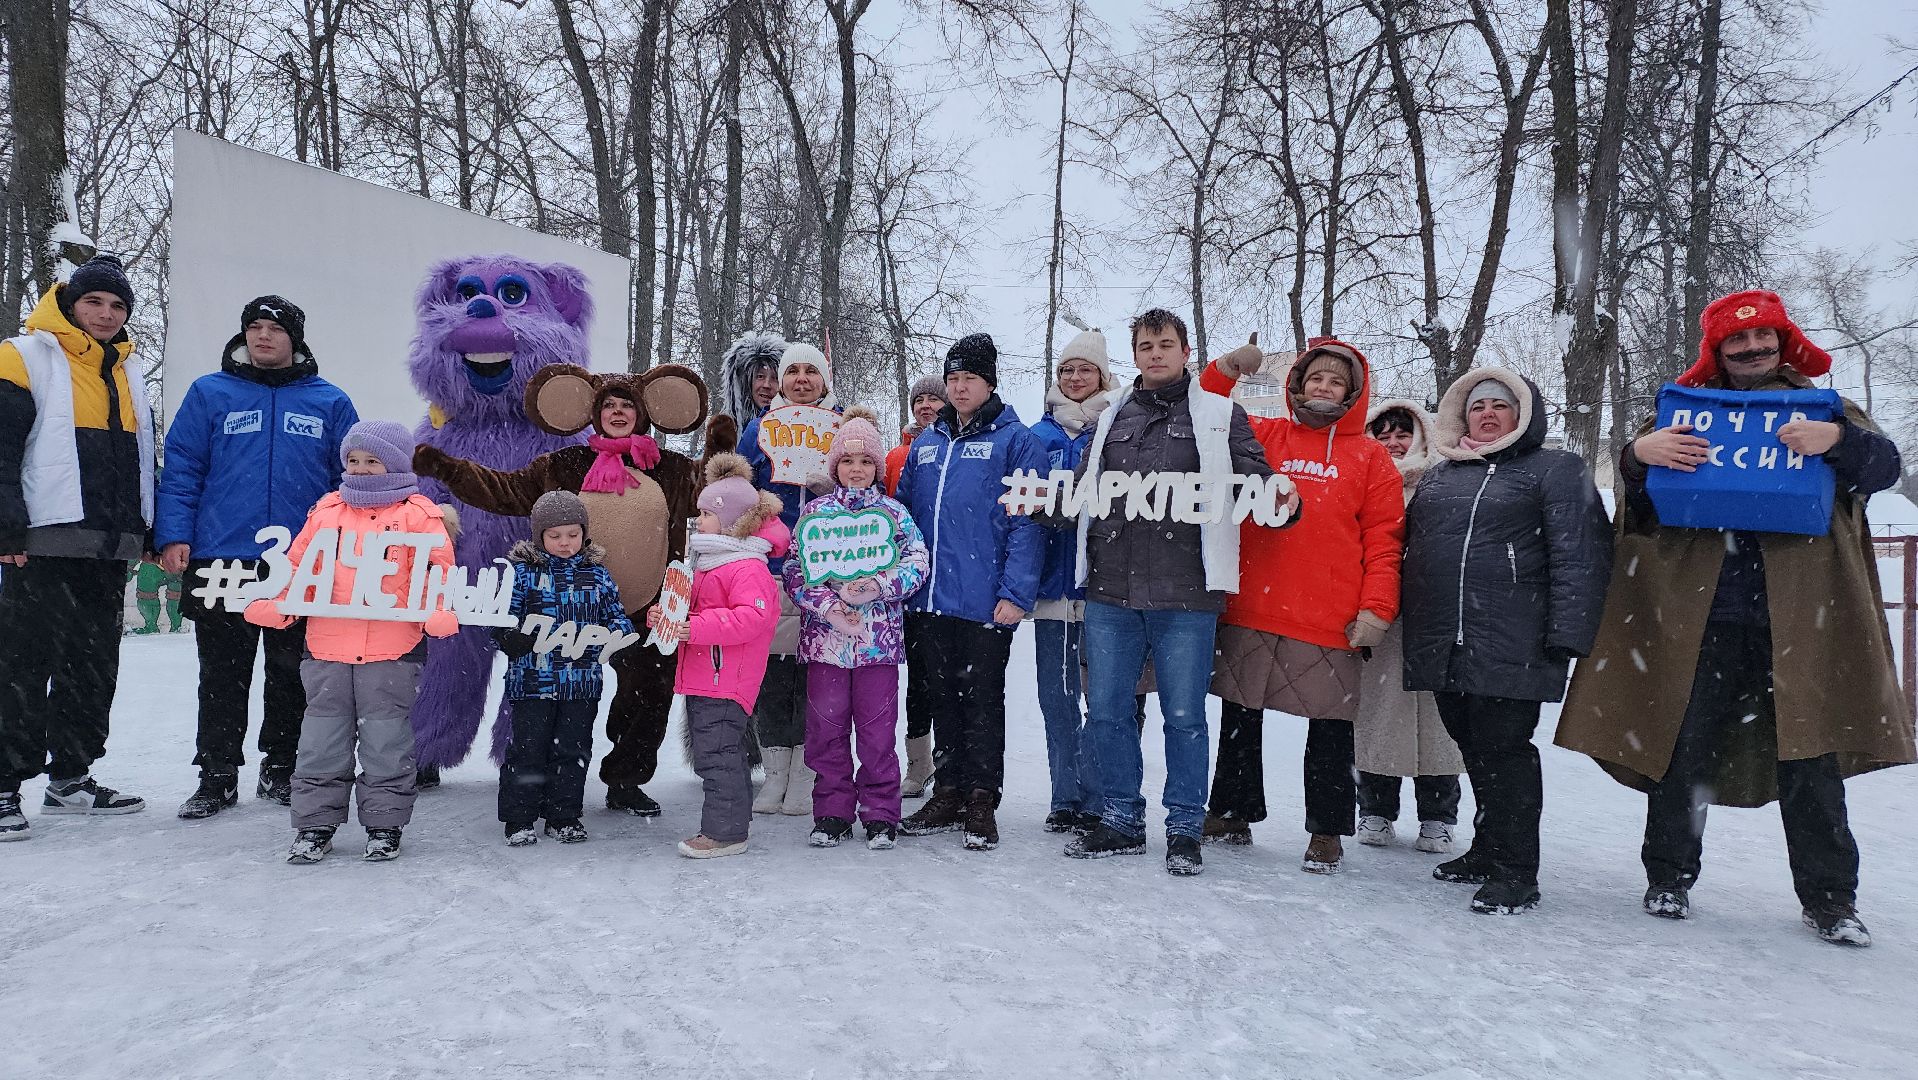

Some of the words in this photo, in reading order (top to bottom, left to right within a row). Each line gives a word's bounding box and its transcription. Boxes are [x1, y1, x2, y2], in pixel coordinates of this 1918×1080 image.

[763, 418, 835, 455] ТАТЬЯ
[1708, 445, 1804, 470] ССИИ
[1280, 459, 1339, 479] ЗИМА
[808, 519, 880, 540] ЛУЧШИЙ
[810, 545, 889, 563] СТУДЕНТ
